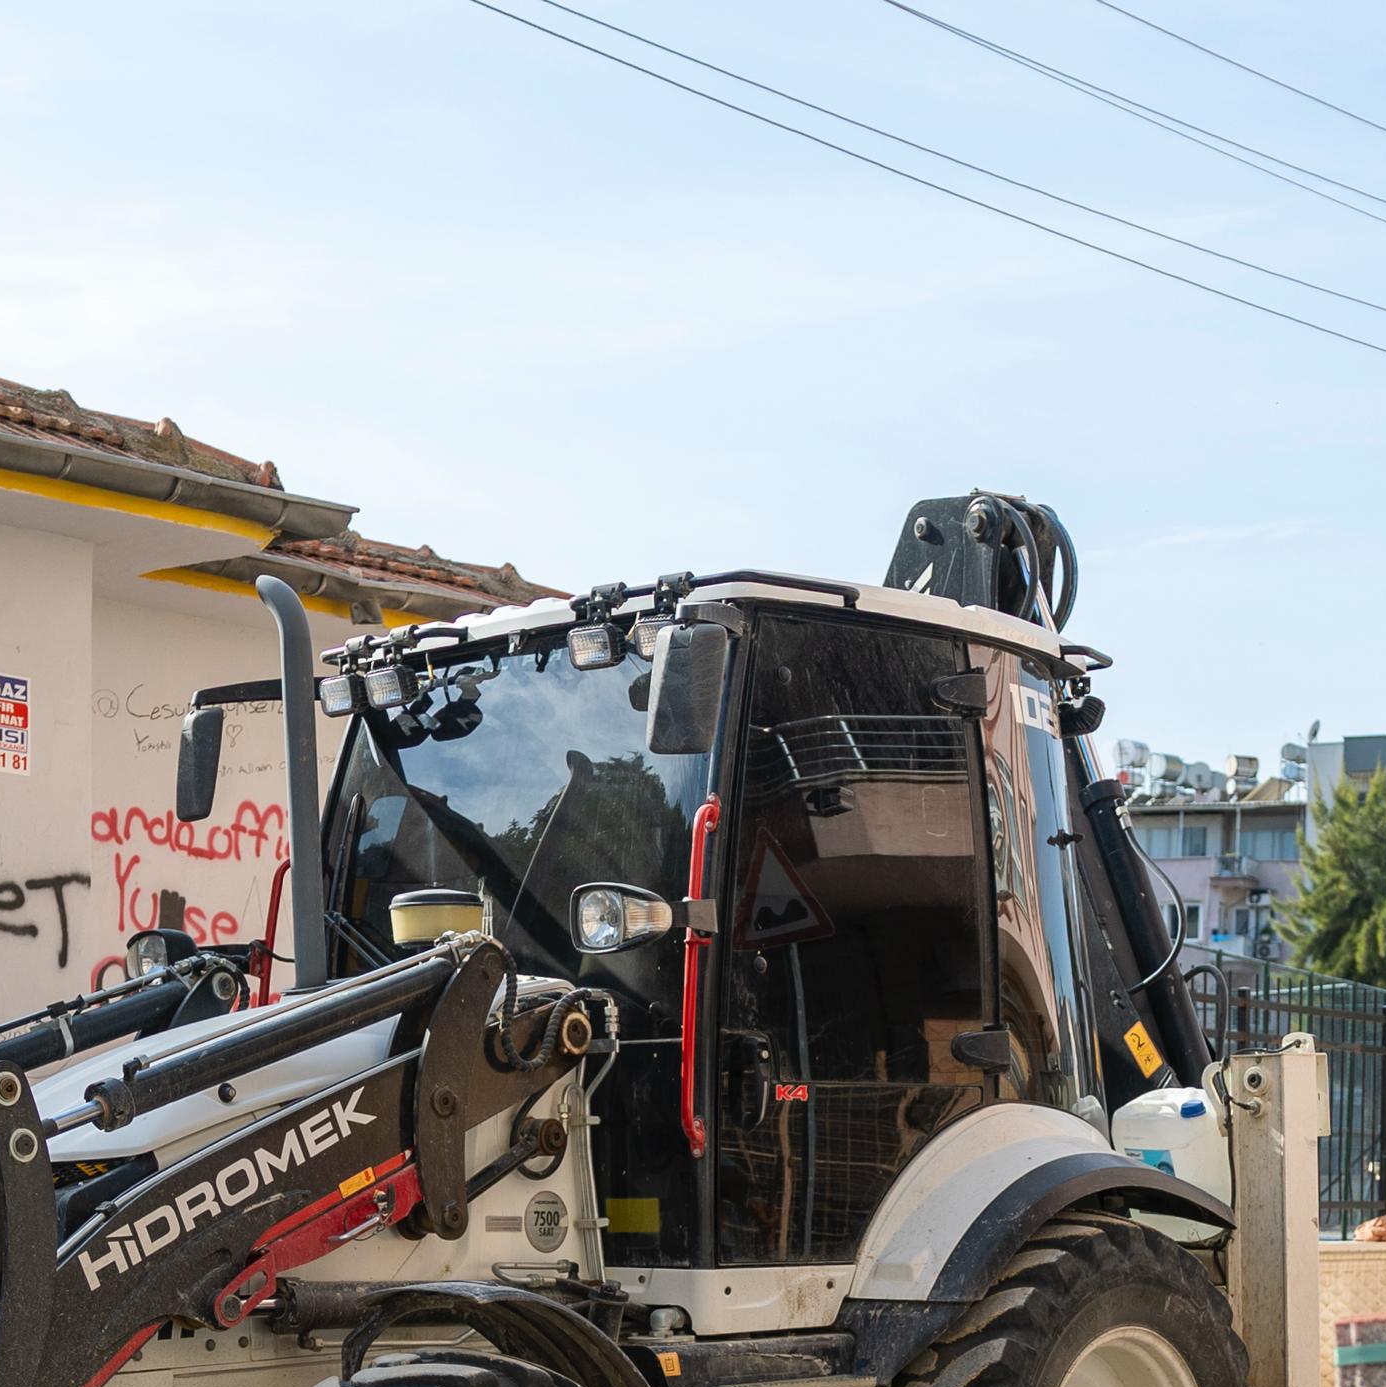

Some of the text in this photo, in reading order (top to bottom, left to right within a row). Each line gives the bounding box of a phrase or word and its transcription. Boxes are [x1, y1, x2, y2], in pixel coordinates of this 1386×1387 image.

[0, 727, 25, 744] ISI
[13, 754, 27, 770] 81
[775, 1083, 809, 1102] K4
[534, 1211, 560, 1227] 7500
[538, 1227, 554, 1237] SAAT
